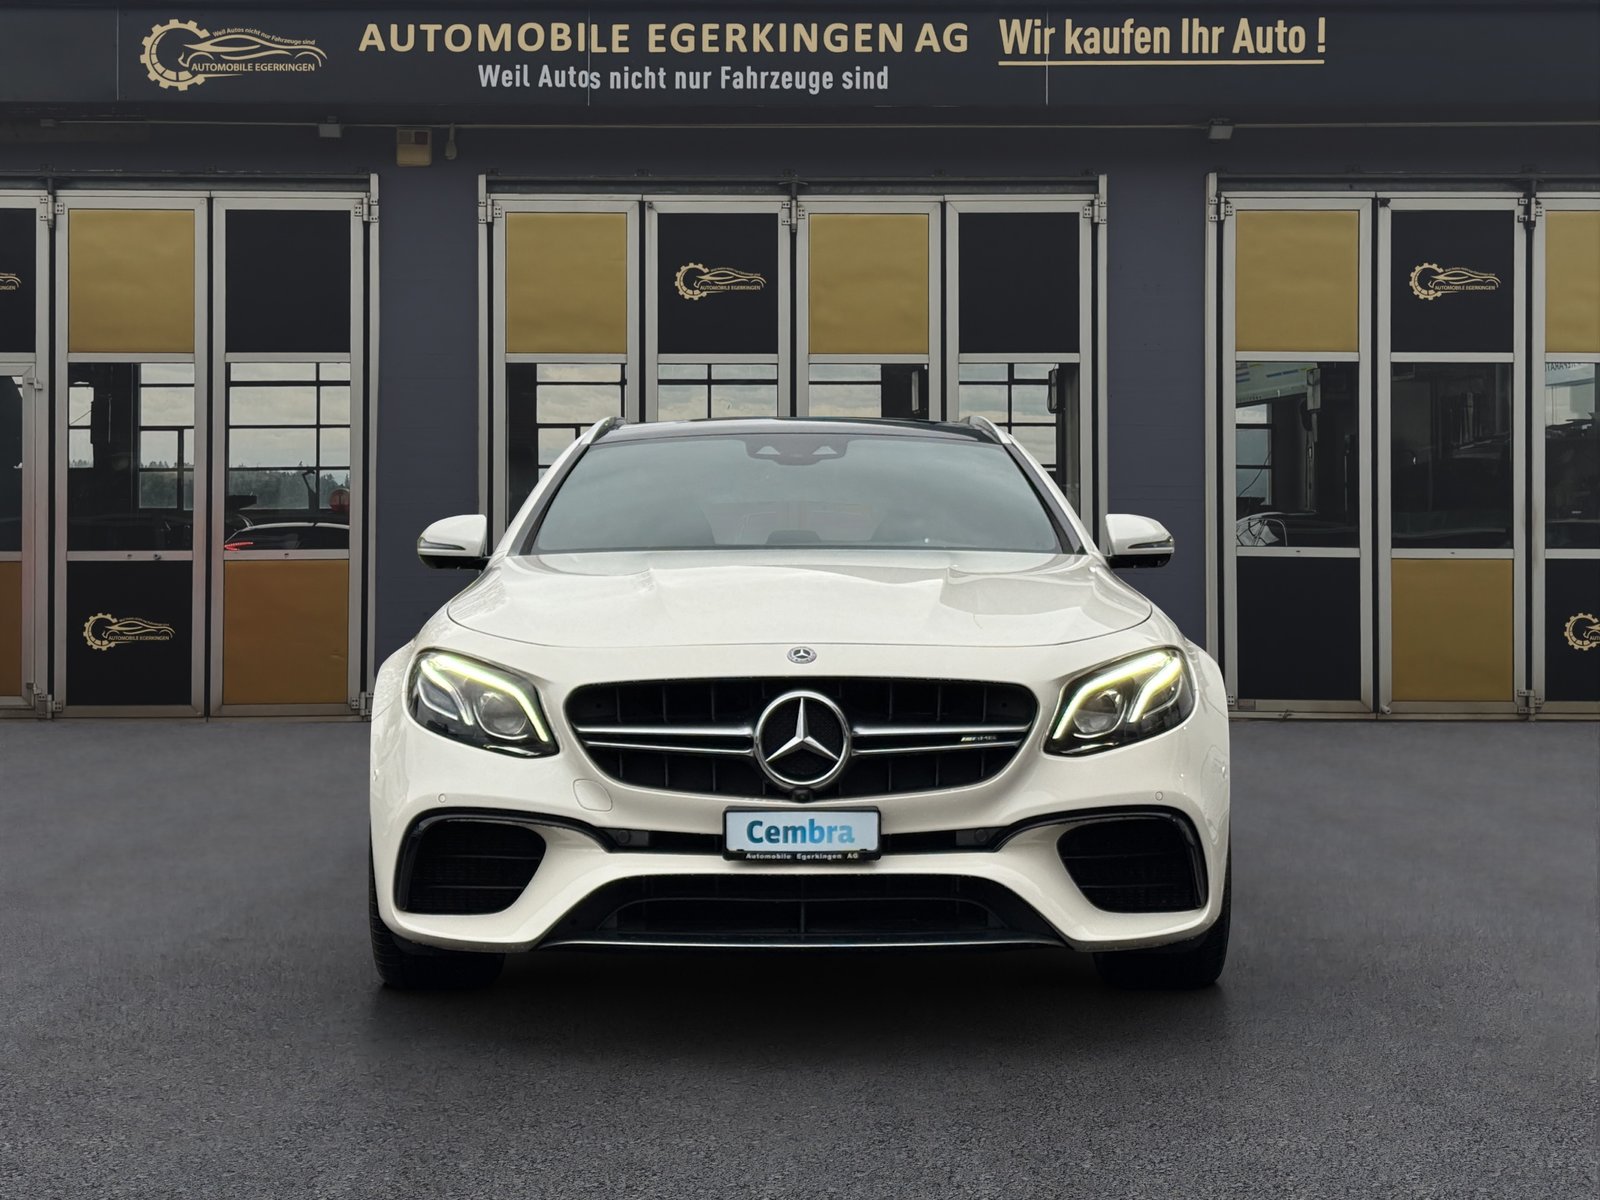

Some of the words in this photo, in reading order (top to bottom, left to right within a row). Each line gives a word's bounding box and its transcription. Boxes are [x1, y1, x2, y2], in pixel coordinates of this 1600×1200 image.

[359, 23, 630, 54] AUTOMOBILE
[648, 22, 903, 53] EGERKINGEN
[914, 22, 968, 53] AG
[999, 19, 1056, 54] Wir
[1064, 18, 1170, 55] kaufen
[1181, 18, 1224, 54] Ihr
[1232, 18, 1306, 54] Auto
[191, 63, 254, 71] AUTOMOBILE
[255, 63, 315, 71] EGERKINGEN
[478, 64, 531, 88] Weil
[538, 65, 601, 89] Autos
[609, 66, 667, 90] nicht
[674, 71, 712, 90] nur
[720, 65, 834, 95] Fahrzeuge
[841, 66, 889, 90] sind
[746, 818, 856, 844] Cembra
[796, 853, 842, 861] Egerkingen
